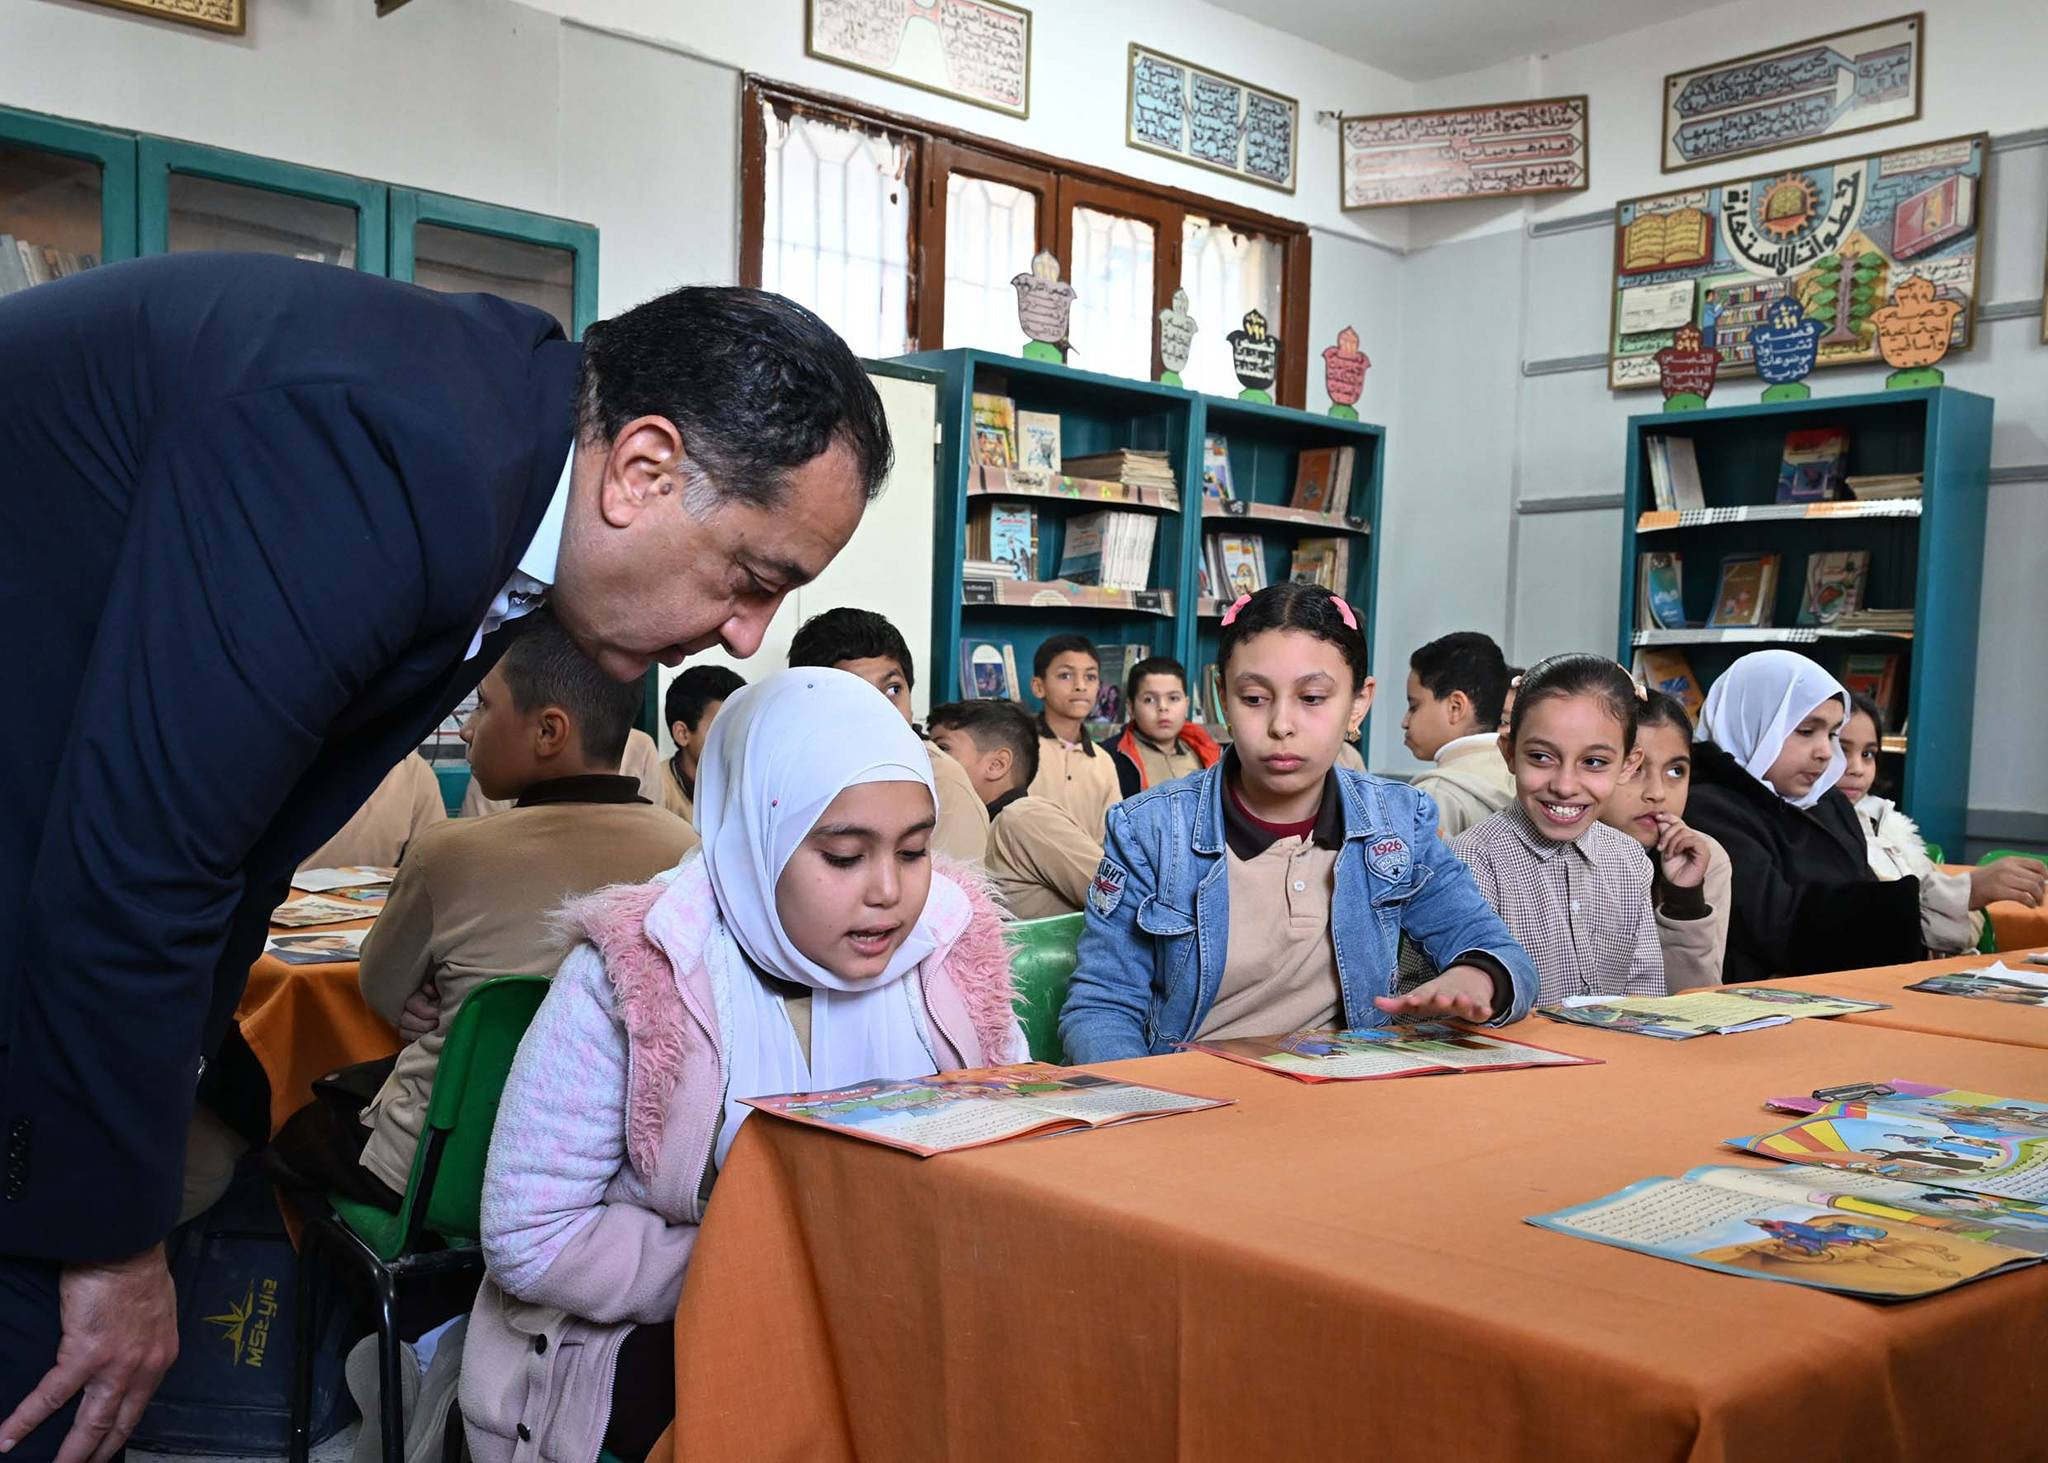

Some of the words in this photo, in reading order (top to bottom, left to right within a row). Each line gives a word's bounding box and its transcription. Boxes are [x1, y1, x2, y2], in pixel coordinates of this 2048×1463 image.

[1796, 169, 1861, 266] خطوات
[1876, 302, 1949, 325] قصص
[1755, 323, 1815, 343] قصص
[1880, 320, 1949, 341] اجتماعية
[1372, 840, 1403, 857] 1926
